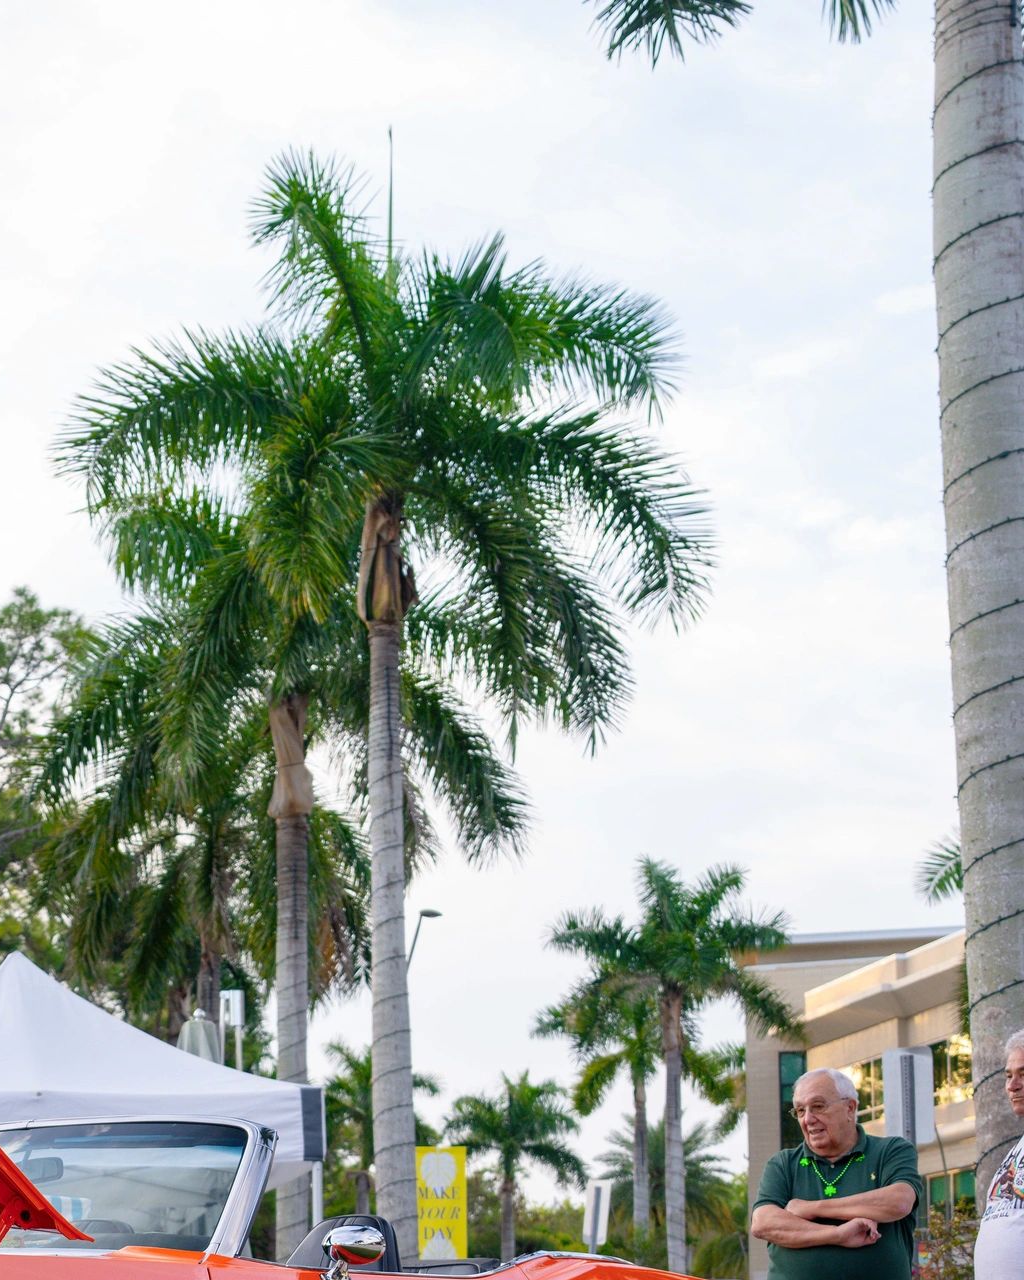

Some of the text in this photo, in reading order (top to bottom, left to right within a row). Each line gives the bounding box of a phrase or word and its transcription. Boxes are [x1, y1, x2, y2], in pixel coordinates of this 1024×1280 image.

[418, 1186, 460, 1199] MAKE
[418, 1206, 461, 1220] YOUR
[424, 1226, 455, 1240] DAY
